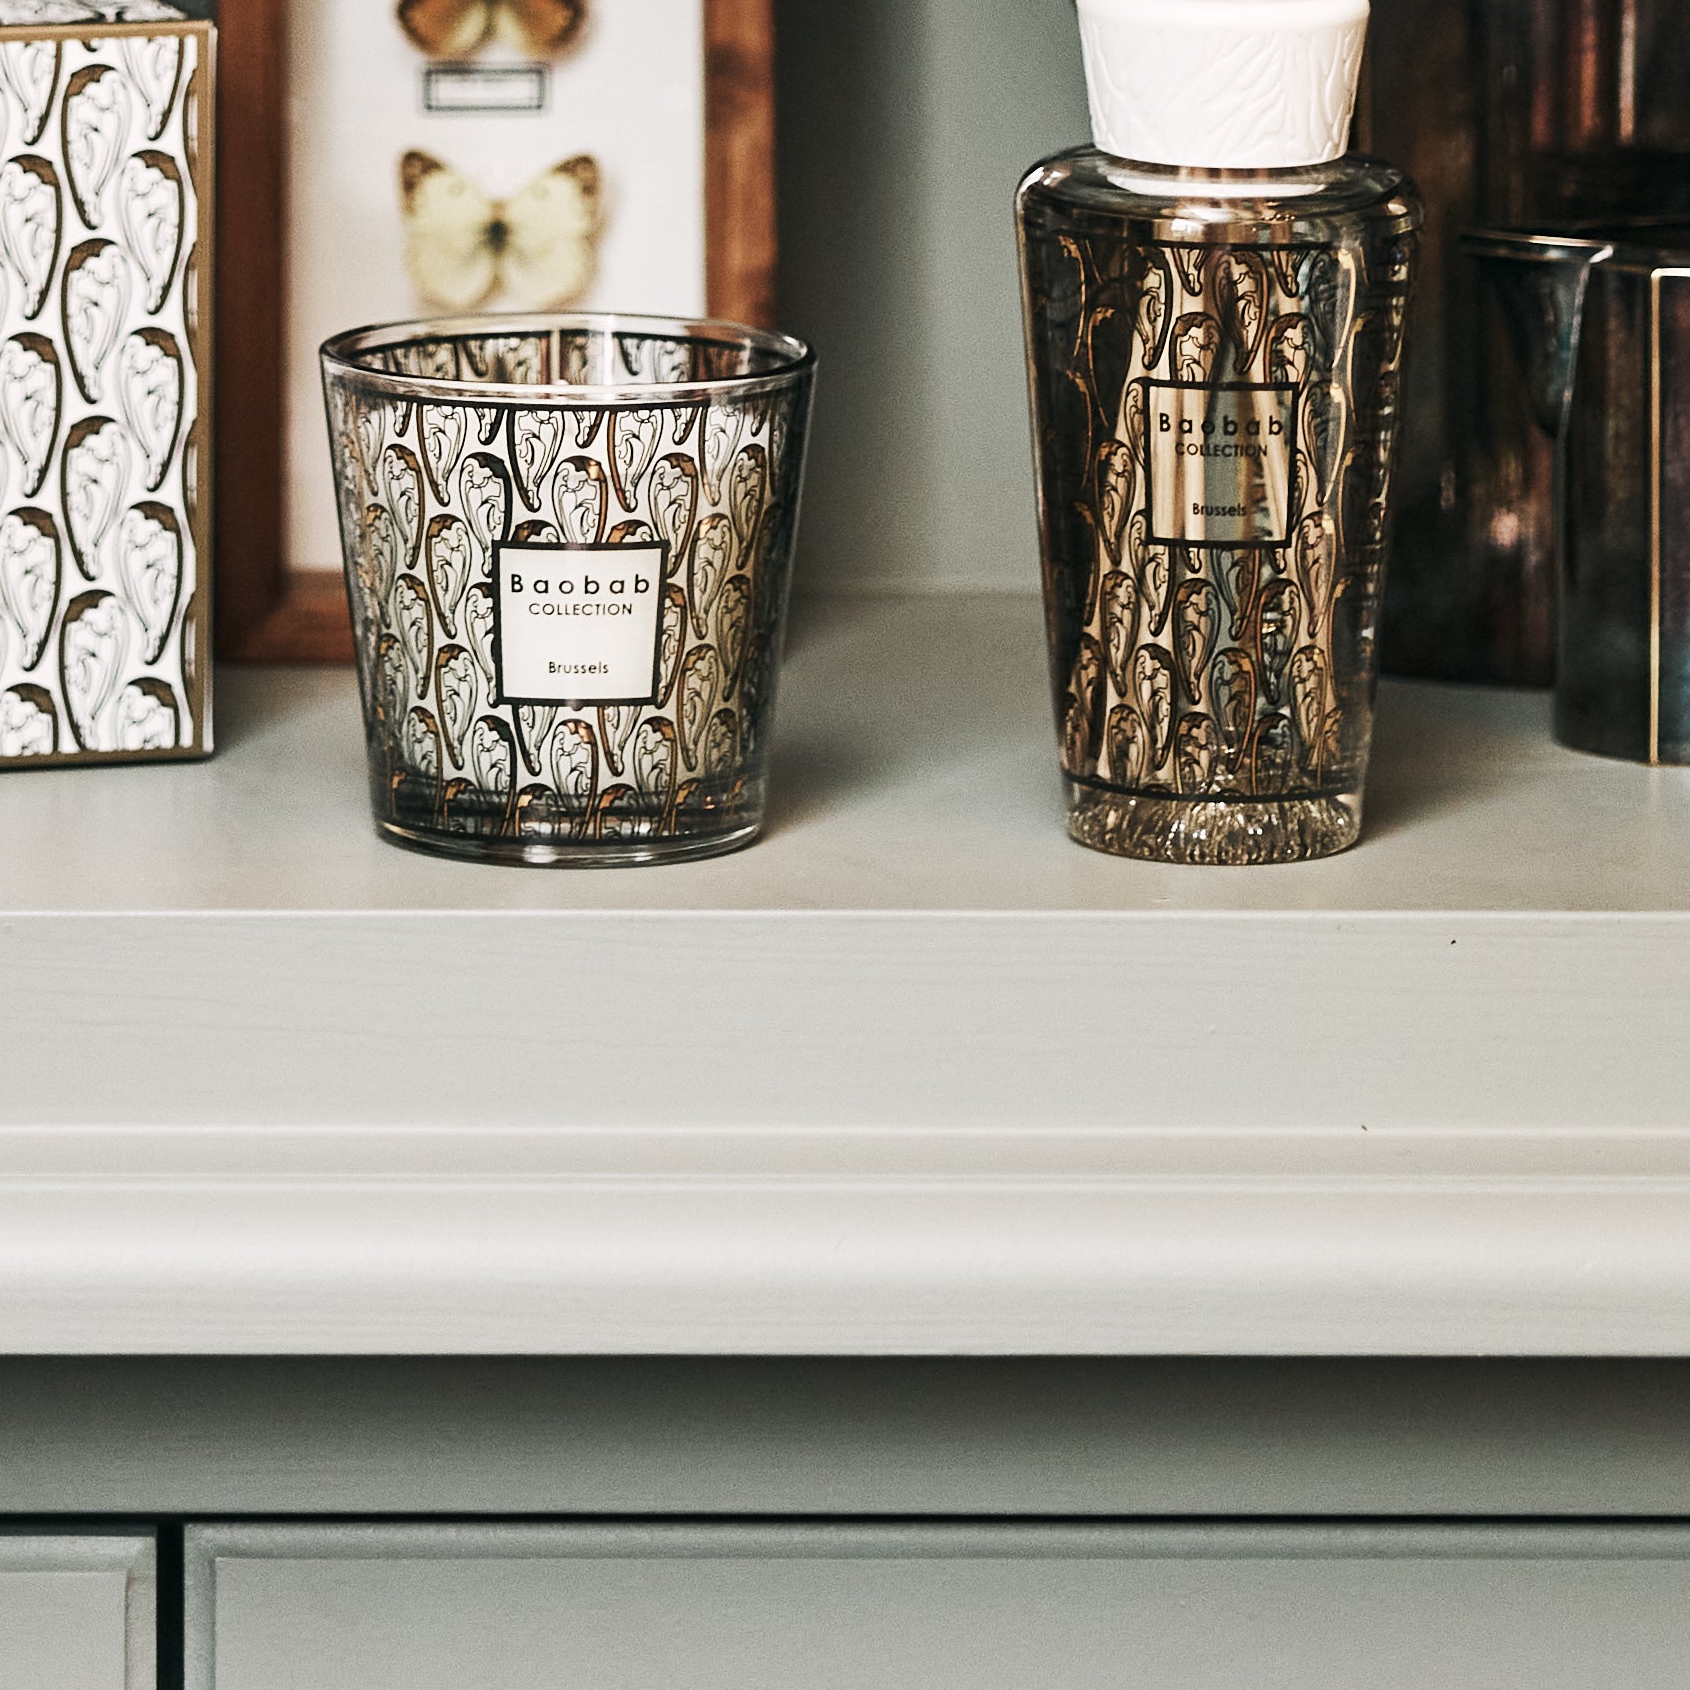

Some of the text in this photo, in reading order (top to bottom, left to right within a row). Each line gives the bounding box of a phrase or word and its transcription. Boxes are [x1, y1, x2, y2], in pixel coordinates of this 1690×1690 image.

[1159, 413, 1283, 436] Baobab
[1175, 443, 1267, 457] COLLECTION
[1192, 502, 1247, 517] Brussels
[511, 574, 649, 594] Baobab
[529, 603, 633, 616] COLLECTION
[549, 661, 609, 674] Brussels
